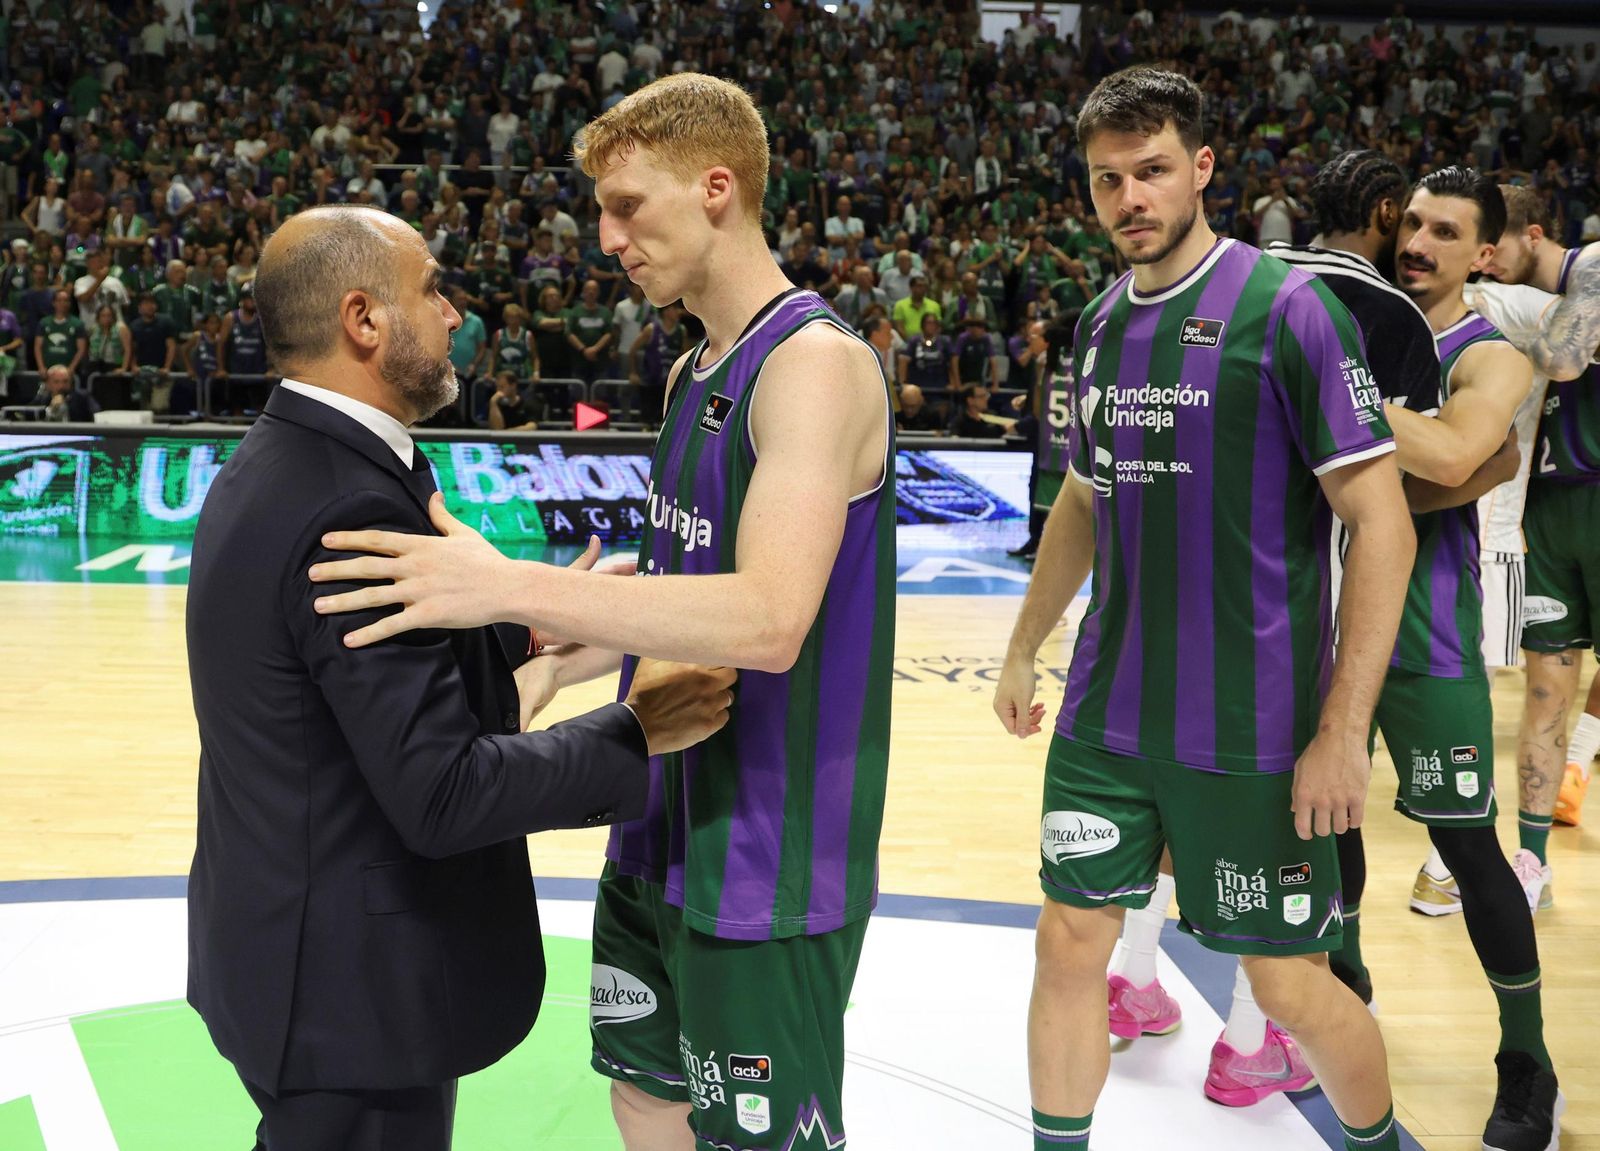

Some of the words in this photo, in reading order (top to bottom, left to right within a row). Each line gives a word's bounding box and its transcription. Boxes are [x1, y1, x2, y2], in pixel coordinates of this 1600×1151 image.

[1105, 383, 1209, 407] Fundación
[1104, 405, 1174, 433] Unicaja
[1115, 460, 1146, 472] COSTA
[1147, 460, 1168, 473] DEL
[1169, 461, 1193, 474] SOL
[1454, 752, 1474, 762] acb
[1283, 872, 1305, 883] acb
[733, 1066, 761, 1078] acb
